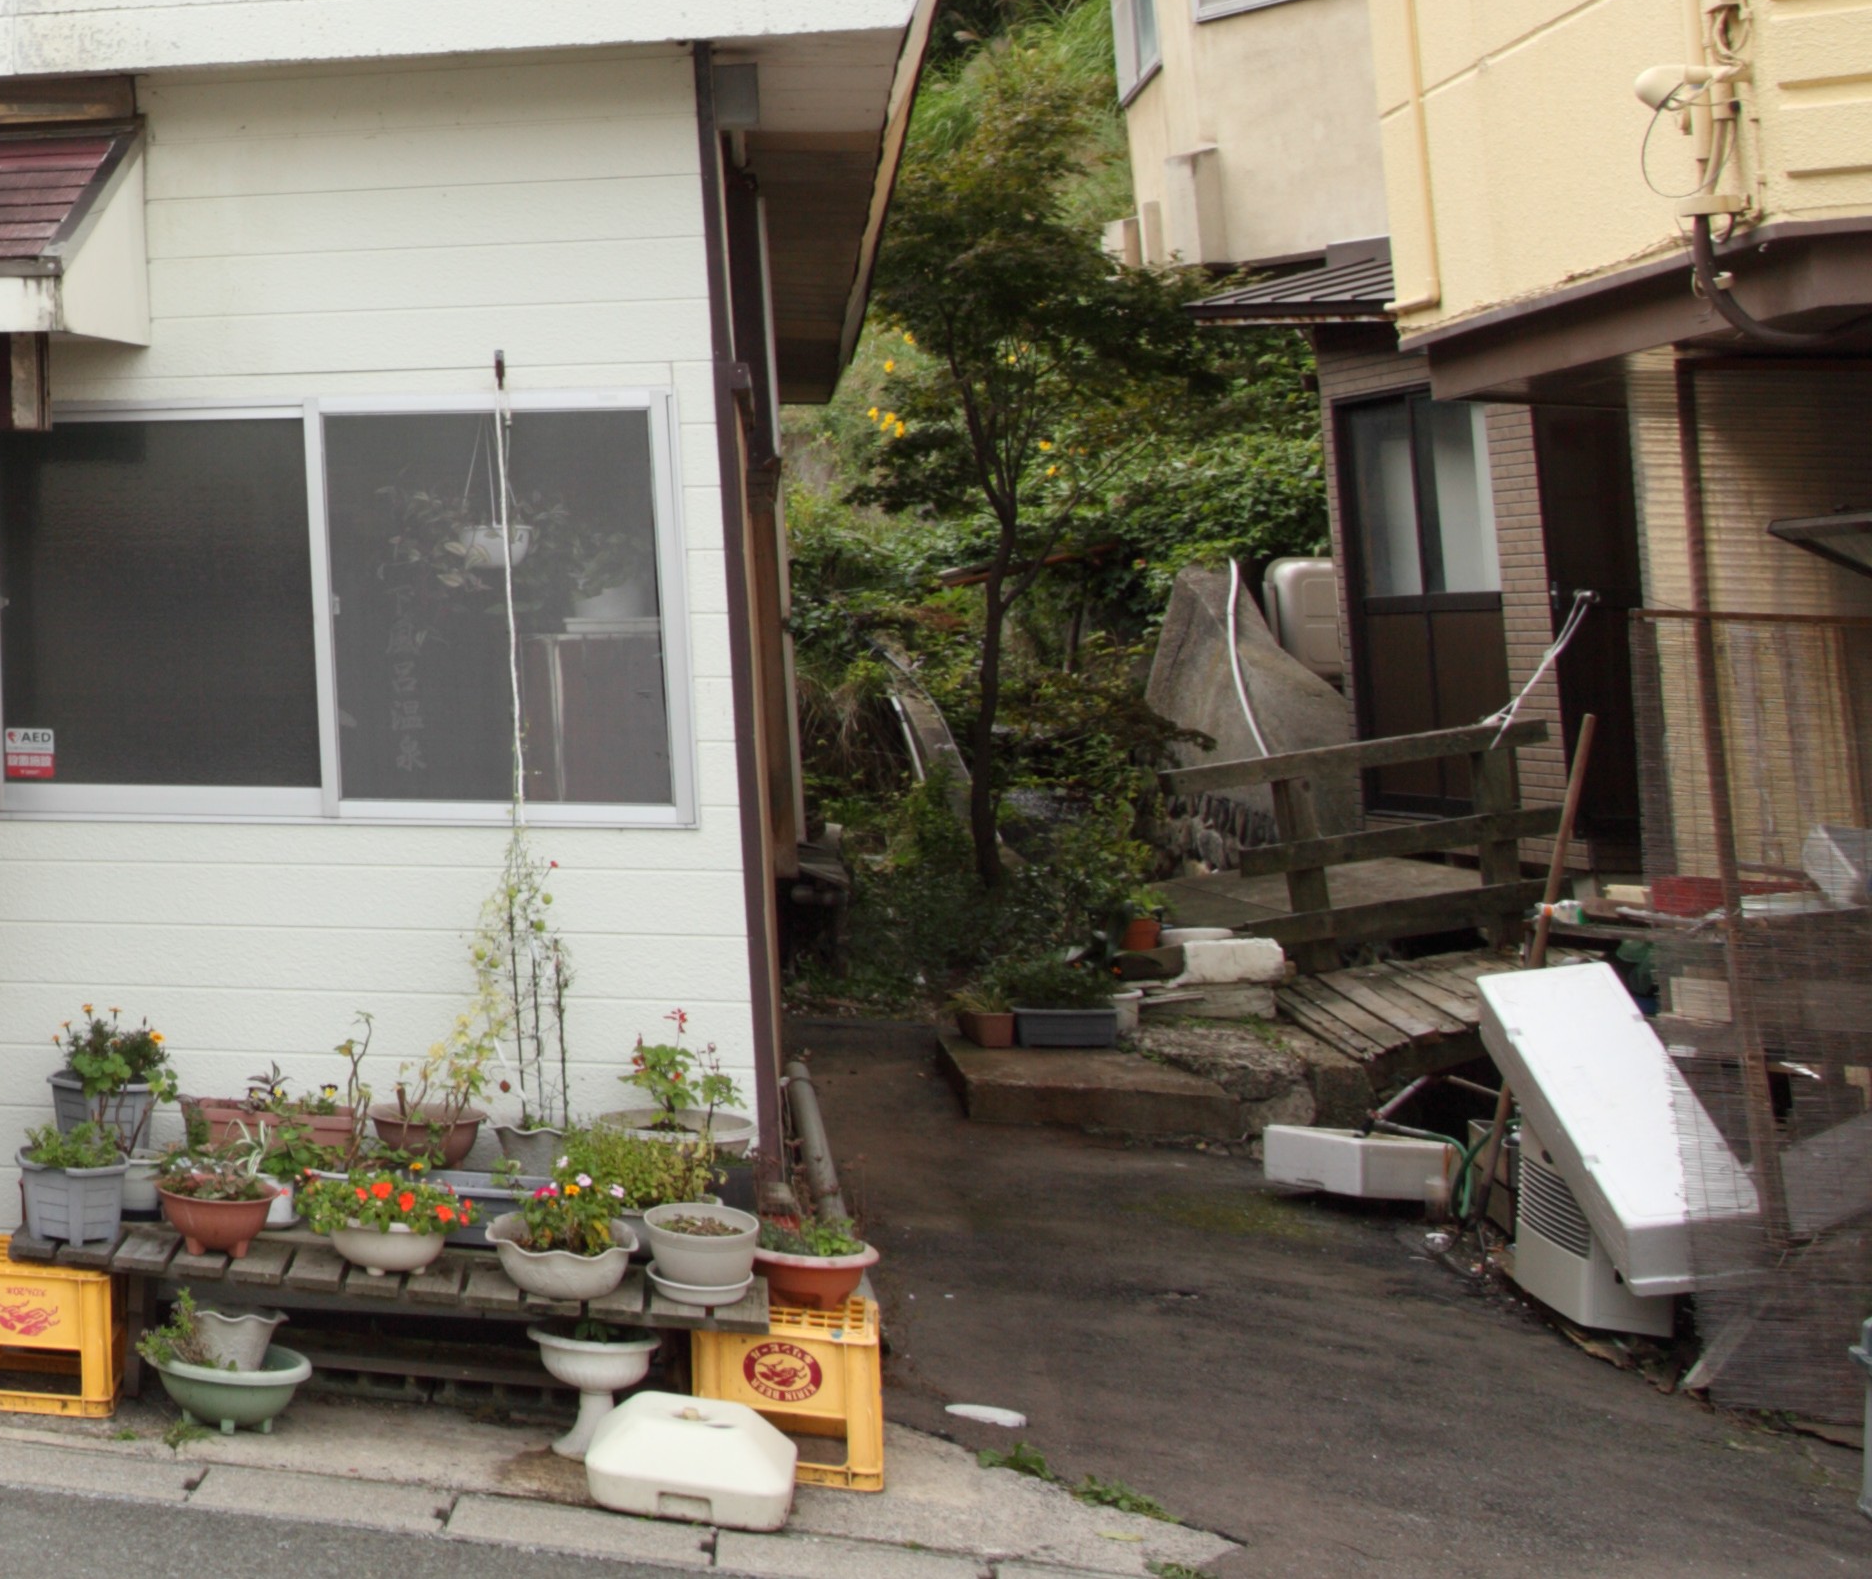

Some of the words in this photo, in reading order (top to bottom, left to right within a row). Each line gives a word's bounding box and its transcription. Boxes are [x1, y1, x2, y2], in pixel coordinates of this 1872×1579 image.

[21, 731, 52, 743] AED
[750, 1377, 781, 1400] BEER
[785, 1382, 817, 1401] KIRIN
